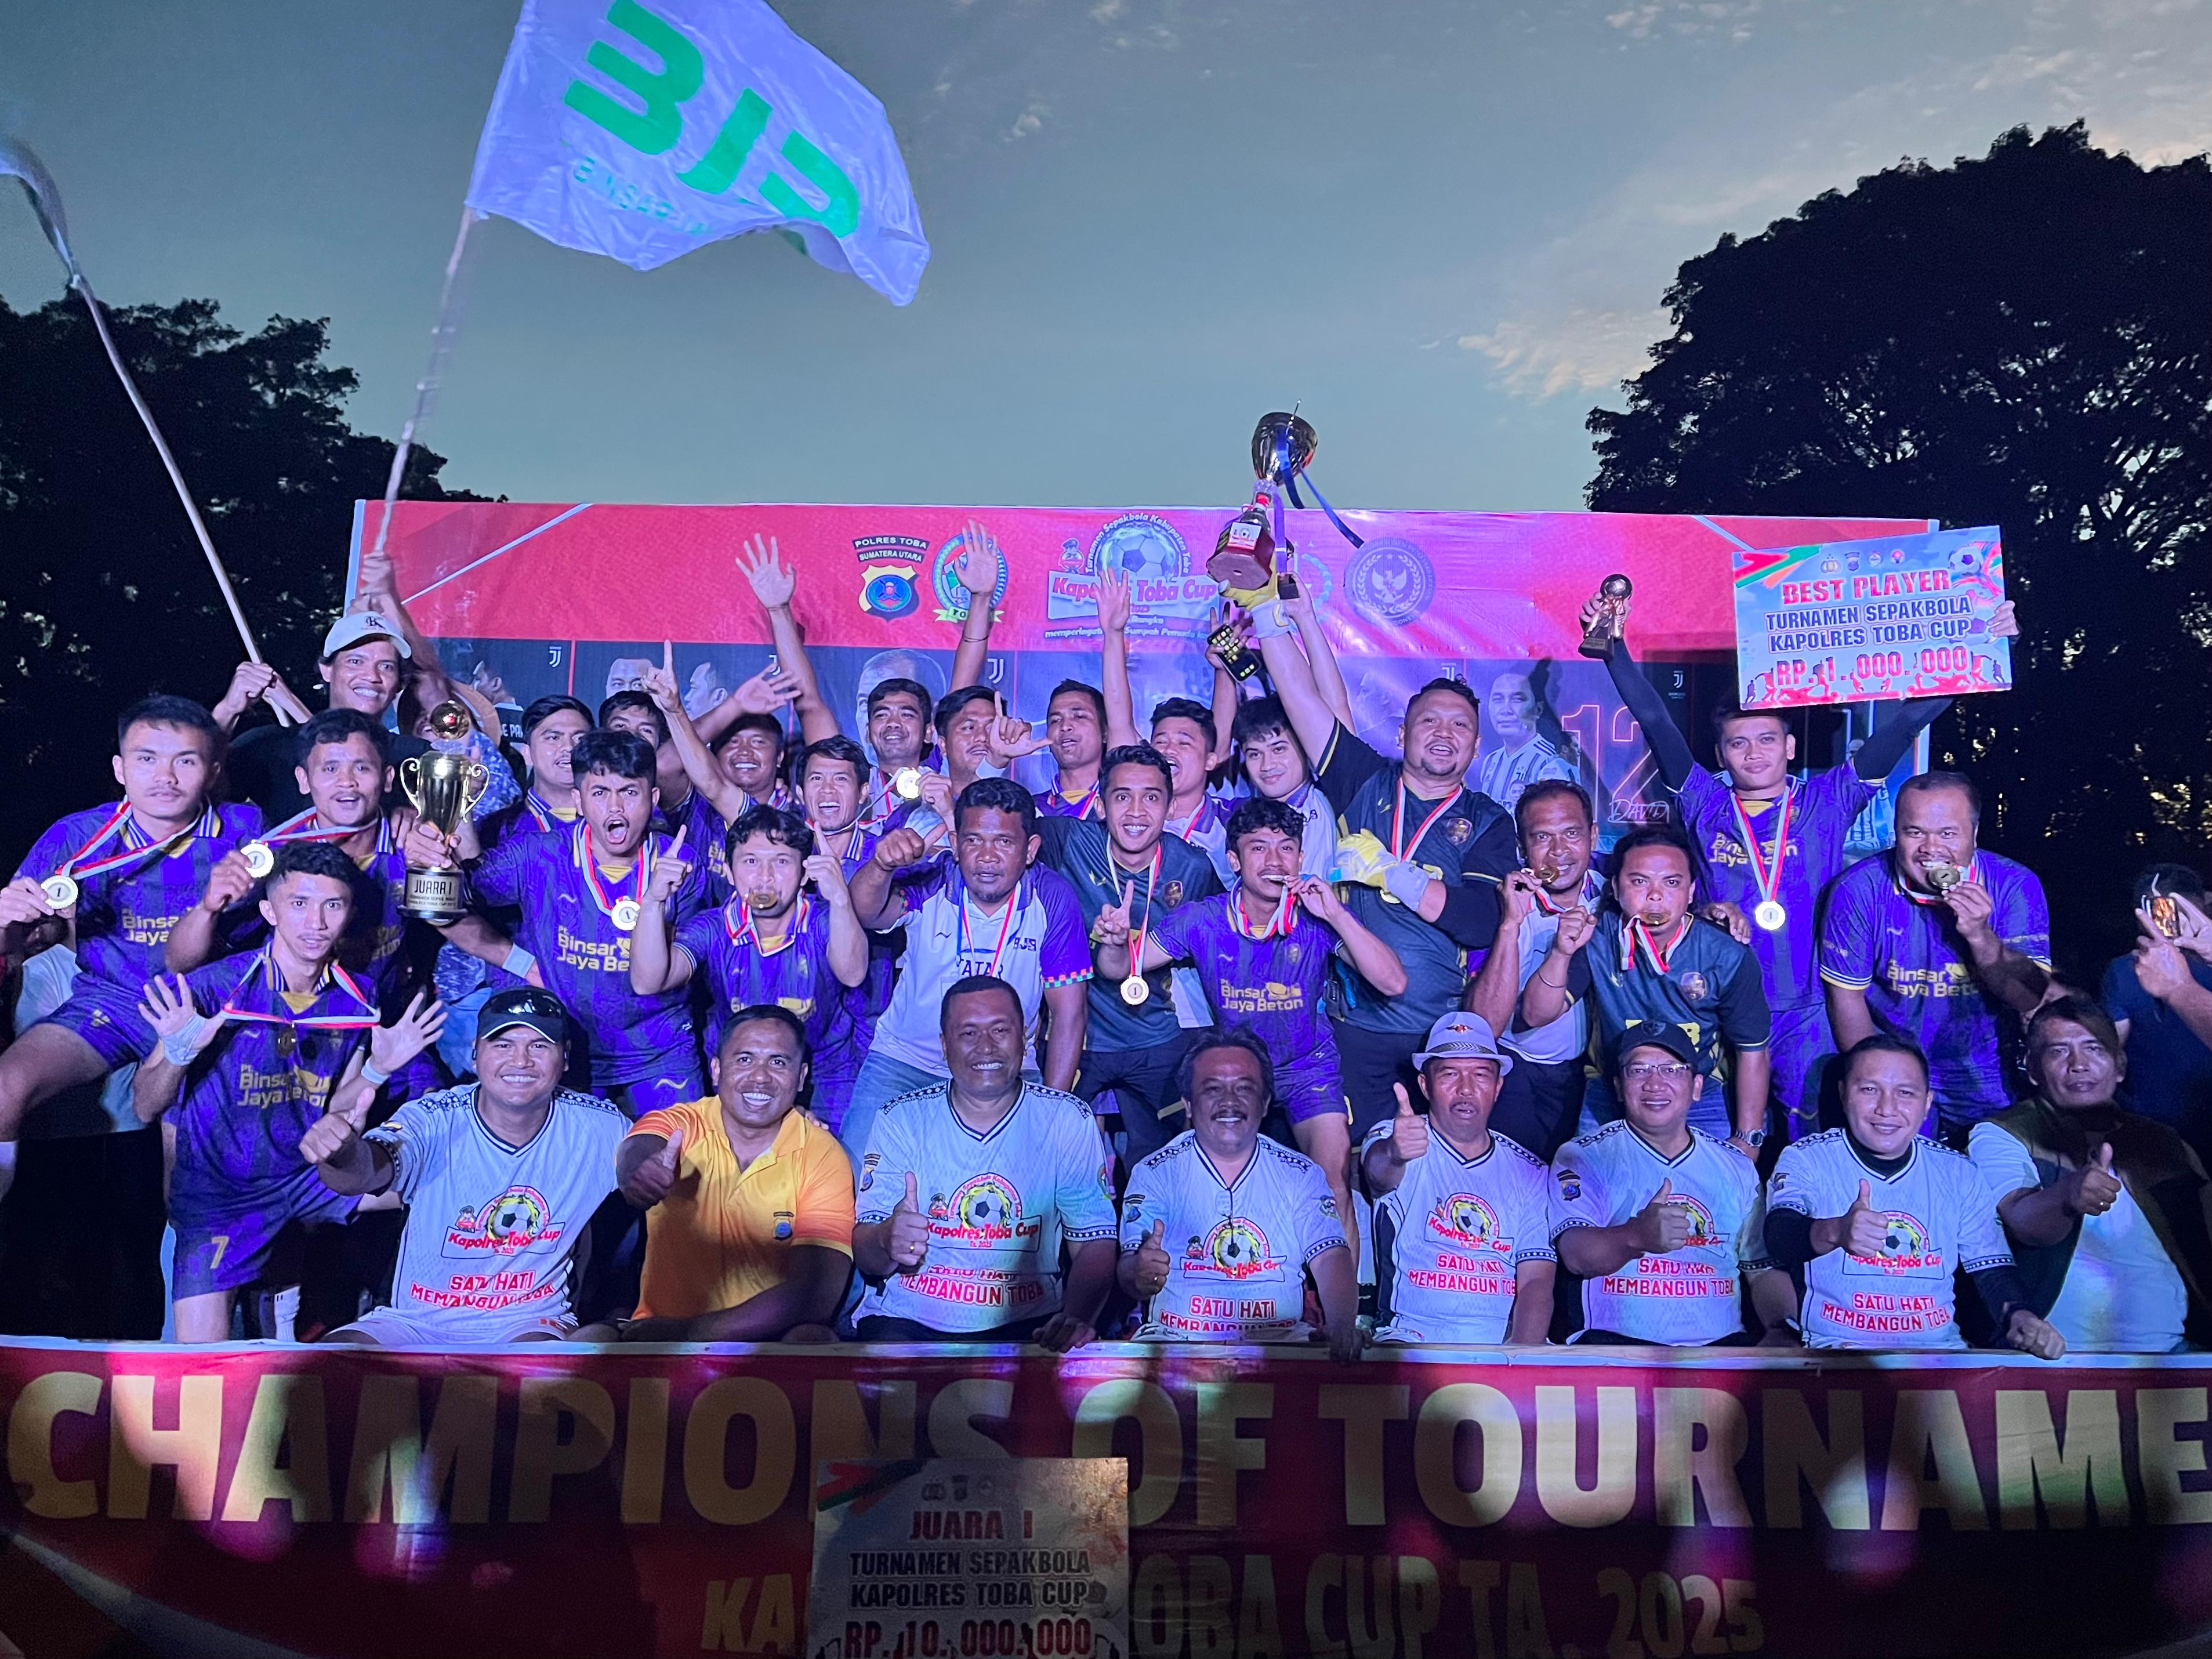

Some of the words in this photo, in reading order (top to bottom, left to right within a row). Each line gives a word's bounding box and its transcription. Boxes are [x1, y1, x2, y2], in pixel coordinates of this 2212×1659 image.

[854, 537, 896, 548] POLRES
[899, 537, 927, 549] TOBA
[1085, 531, 1104, 573] Turnamen
[1103, 513, 1148, 533] Sepakbola
[1149, 515, 1187, 551] Kabupaten
[1182, 552, 1191, 574] Toba
[859, 550, 898, 562] SUMATERA
[898, 551, 922, 562] UTARA
[1137, 580, 1178, 602] Toba
[1183, 579, 1217, 602] Cup
[1782, 579, 1844, 605] BEST
[1854, 569, 1950, 598] PLAYER
[952, 609, 967, 618] TO
[1765, 606, 1858, 631] TURNAMEN
[1865, 596, 1972, 622] SEPAKBOLA
[1124, 626, 1159, 636] Sumpah
[1161, 627, 1196, 637] Pemuda
[1770, 627, 1866, 653] KAPOLRES
[1873, 622, 1923, 644] TOBA
[1930, 617, 1971, 639] CUP
[1709, 849, 1748, 867] Jaya
[415, 879, 446, 894] JUARA
[122, 915, 179, 929] Binsa
[125, 929, 169, 946] Jaya
[559, 932, 618, 957] Binsar
[557, 948, 600, 970] Jaya
[958, 958, 1003, 980] ATAR
[1887, 965, 1946, 983] Binsar
[1220, 984, 1267, 999] Binsar
[1933, 981, 1979, 998] Bet
[1221, 997, 1255, 1013] Jaya
[1257, 997, 1304, 1012] Beton
[240, 1071, 288, 1090] Binsa
[237, 1089, 283, 1109] Jaya
[929, 1222, 980, 1240] Kapolres
[984, 1223, 1012, 1239] Toba
[1016, 1222, 1039, 1238] Cup
[210, 1235, 231, 1270] 7
[1492, 1240, 1511, 1252] Cup
[1437, 1253, 1476, 1272] SATU
[1638, 1258, 1681, 1276] SATU
[1896, 1254, 1921, 1268] Toba
[1925, 1253, 1942, 1267] Cup
[494, 1271, 535, 1292] HATI
[899, 1273, 1003, 1306] MEMBANGUN
[1408, 1270, 1499, 1295] MEMBANGUN
[1501, 1278, 1515, 1296] TOB
[1602, 1276, 1708, 1298] MEMBANGUN
[1190, 1295, 1235, 1318] SATU
[1239, 1299, 1276, 1320] HATI
[1852, 1292, 1896, 1312] SATU
[1900, 1296, 1935, 1312] HATI
[1822, 1302, 1924, 1332] MEMBANGUN
[1072, 1377, 1274, 1529] OF
[910, 1510, 1005, 1541] JUARA
[850, 1551, 962, 1576] TURNAMEN
[969, 1549, 1091, 1575] SEPAKBOLA
[851, 1583, 965, 1608] KAPOLRES
[977, 1582, 1034, 1607] TOBA
[1042, 1581, 1088, 1606] CUP
[1129, 1553, 1281, 1659] OBA
[1304, 1552, 1441, 1659] CUP
[1596, 1567, 1765, 1659] 2025
